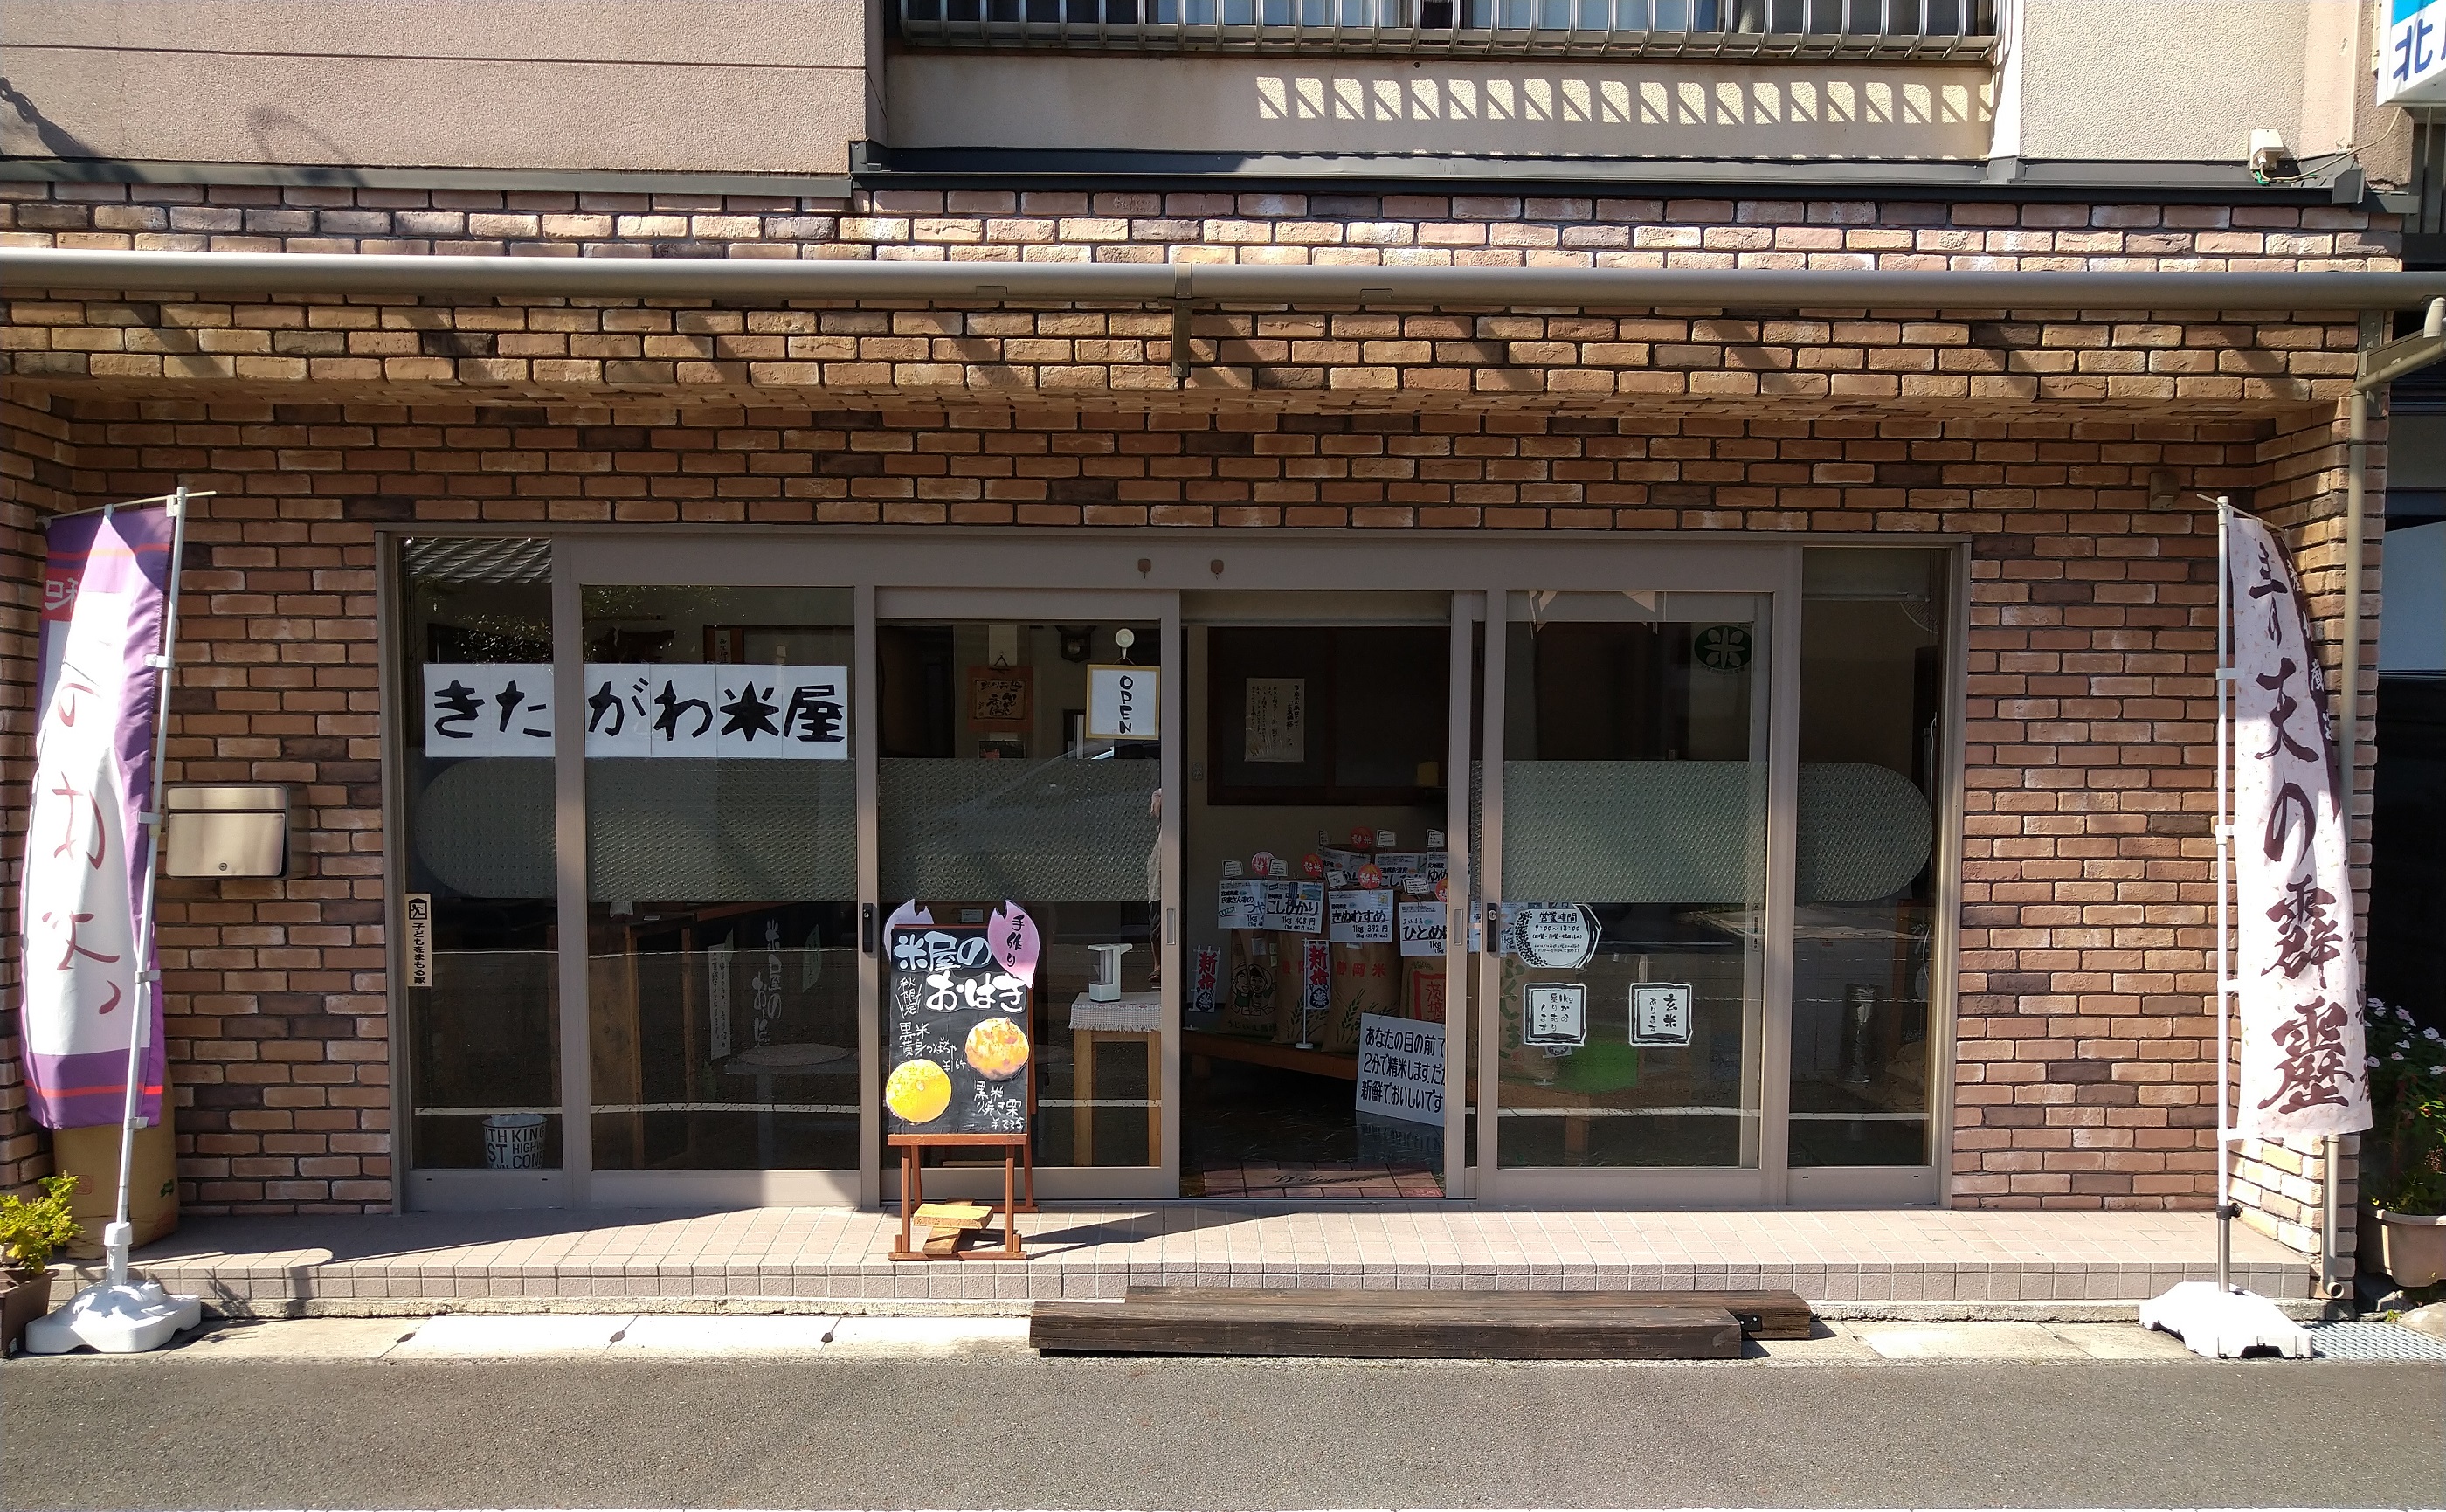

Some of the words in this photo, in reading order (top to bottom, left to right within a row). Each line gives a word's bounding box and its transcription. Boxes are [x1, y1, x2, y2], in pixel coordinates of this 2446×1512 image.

[2393, 18, 2446, 81] 北
[433, 678, 845, 742] きたがわ米屋
[1119, 674, 1134, 735] OPEN
[1332, 910, 1386, 924] きぬむすめ
[1353, 925, 1364, 934] 1kg
[1539, 911, 1578, 923] 営業時間
[412, 922, 426, 984] 子どもをまもる家
[893, 930, 993, 972] 米屋の
[1005, 914, 1026, 968] 手作り
[1429, 941, 1441, 949] 1kg
[897, 977, 921, 1017] 秋限定
[1663, 993, 1678, 1029] 玄米
[899, 1021, 931, 1041] 黒米
[899, 1037, 957, 1058] 黄身かぼちゃ
[973, 1080, 1005, 1102] 黒米
[976, 1098, 1023, 1118] 焼き栗
